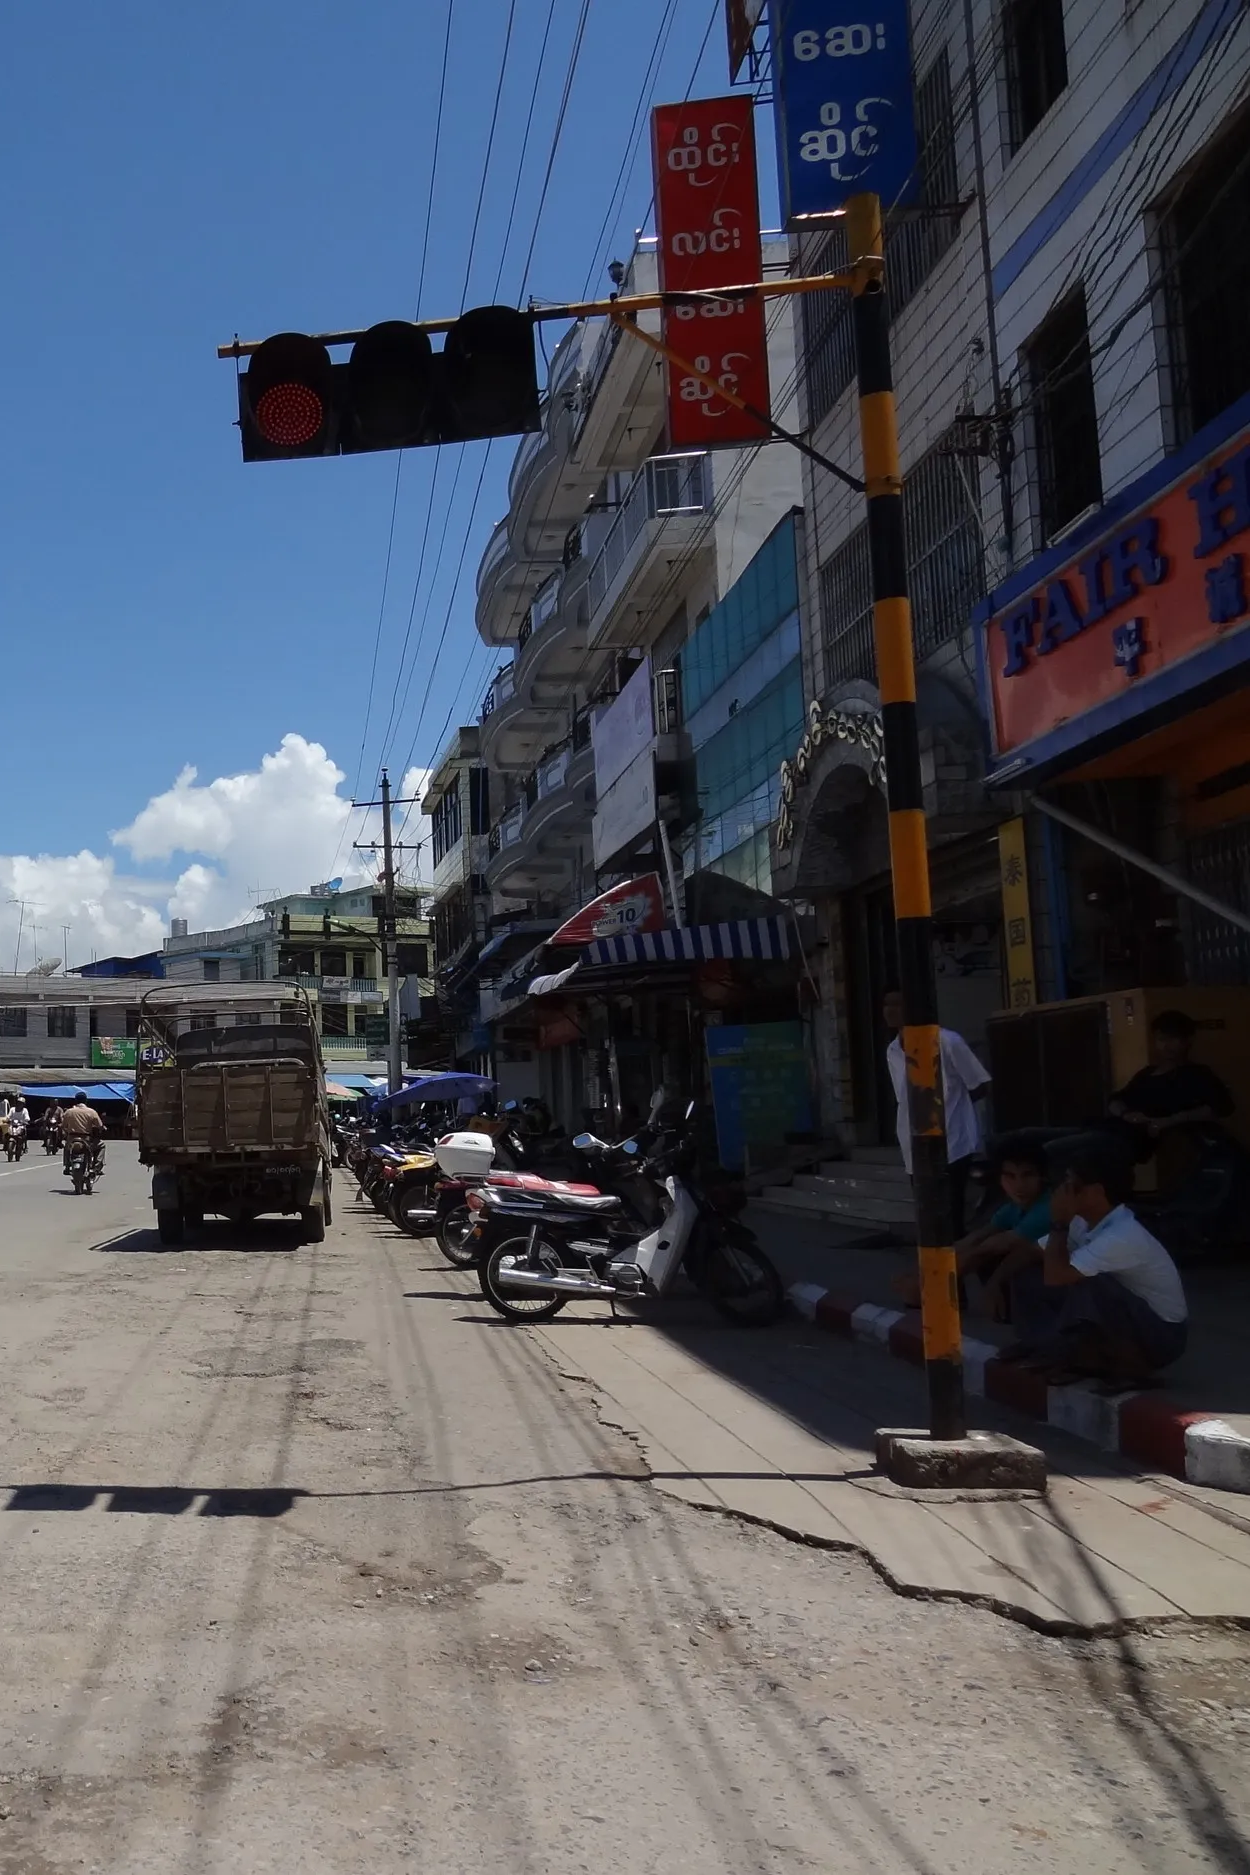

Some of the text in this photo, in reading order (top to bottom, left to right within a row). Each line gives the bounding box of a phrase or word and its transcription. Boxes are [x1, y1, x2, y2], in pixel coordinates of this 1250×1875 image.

[1000, 516, 1170, 678] FAIR
[617, 908, 637, 923] 10
[142, 1048, 165, 1061] E-LA
